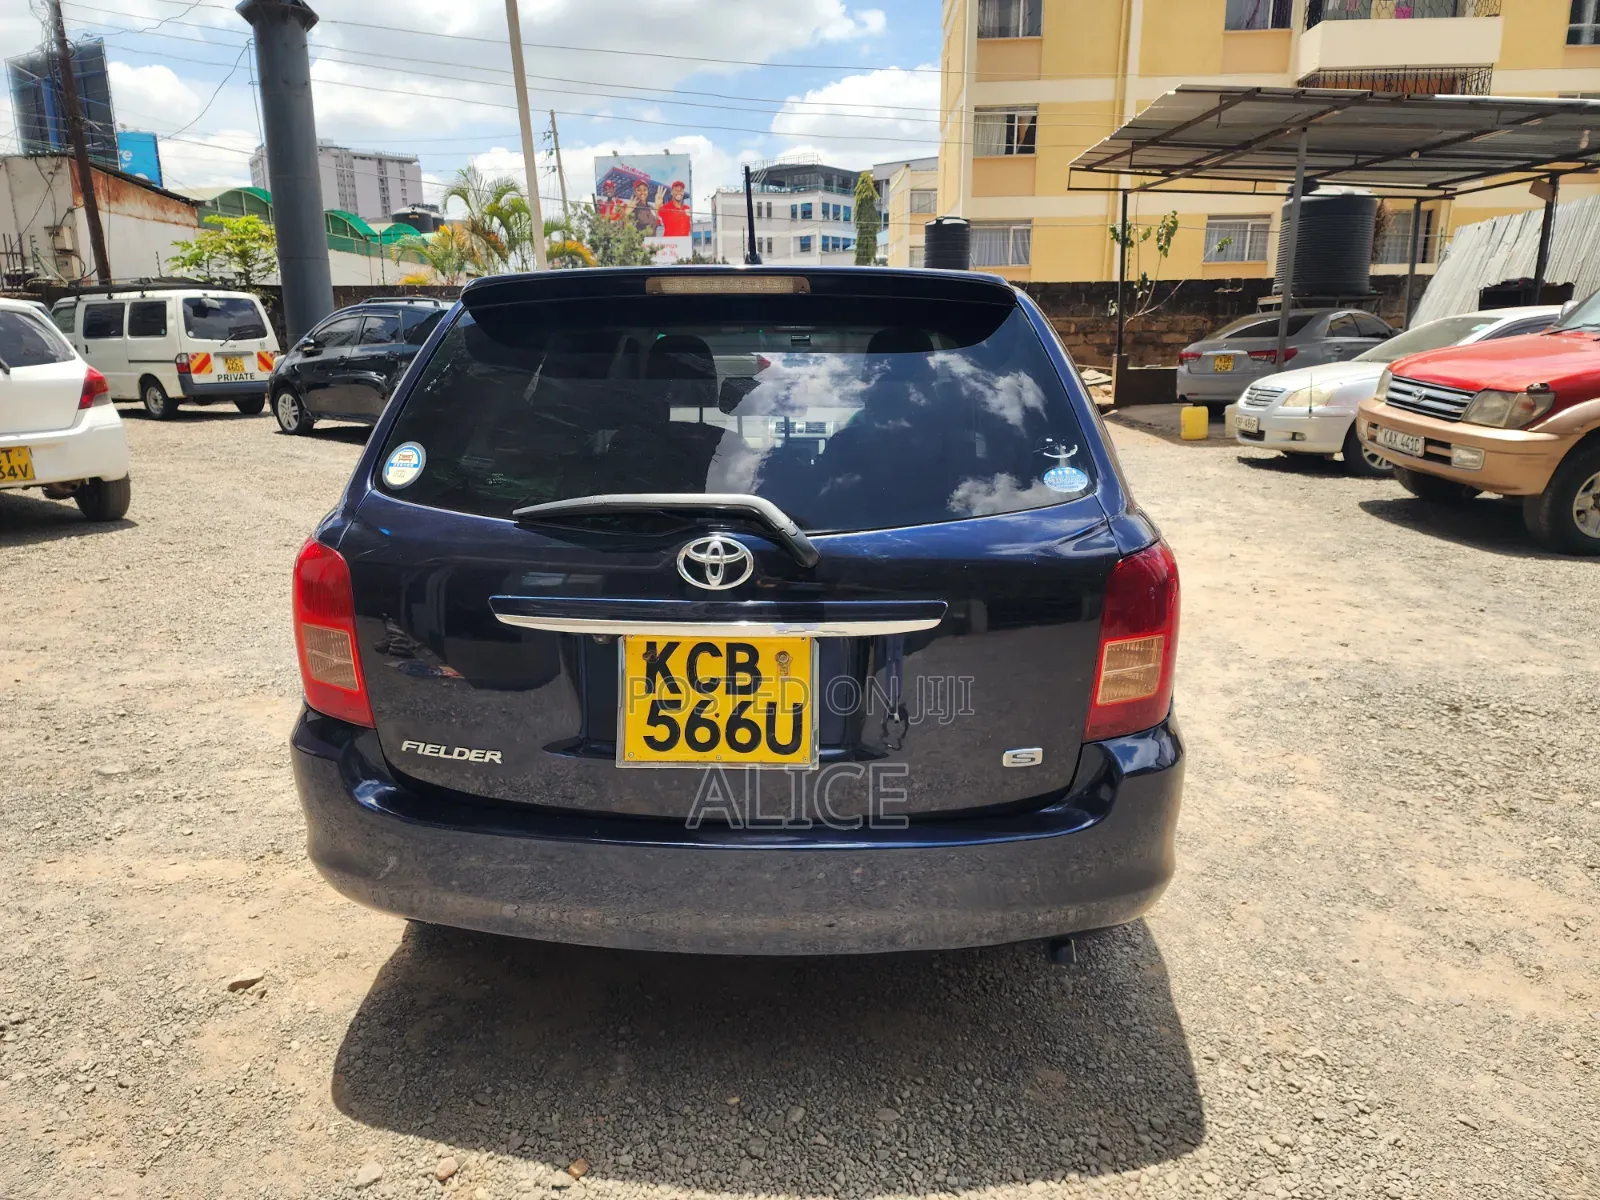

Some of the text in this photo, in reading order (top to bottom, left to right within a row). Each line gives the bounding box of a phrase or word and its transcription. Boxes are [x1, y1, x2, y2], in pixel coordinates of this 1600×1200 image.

[217, 372, 255, 382] PRIVATE
[1384, 430, 1420, 452] KAX 441C
[0, 449, 12, 464] T
[645, 641, 762, 696] KCB
[642, 700, 803, 755] 566U
[401, 740, 502, 764] FIELDER
